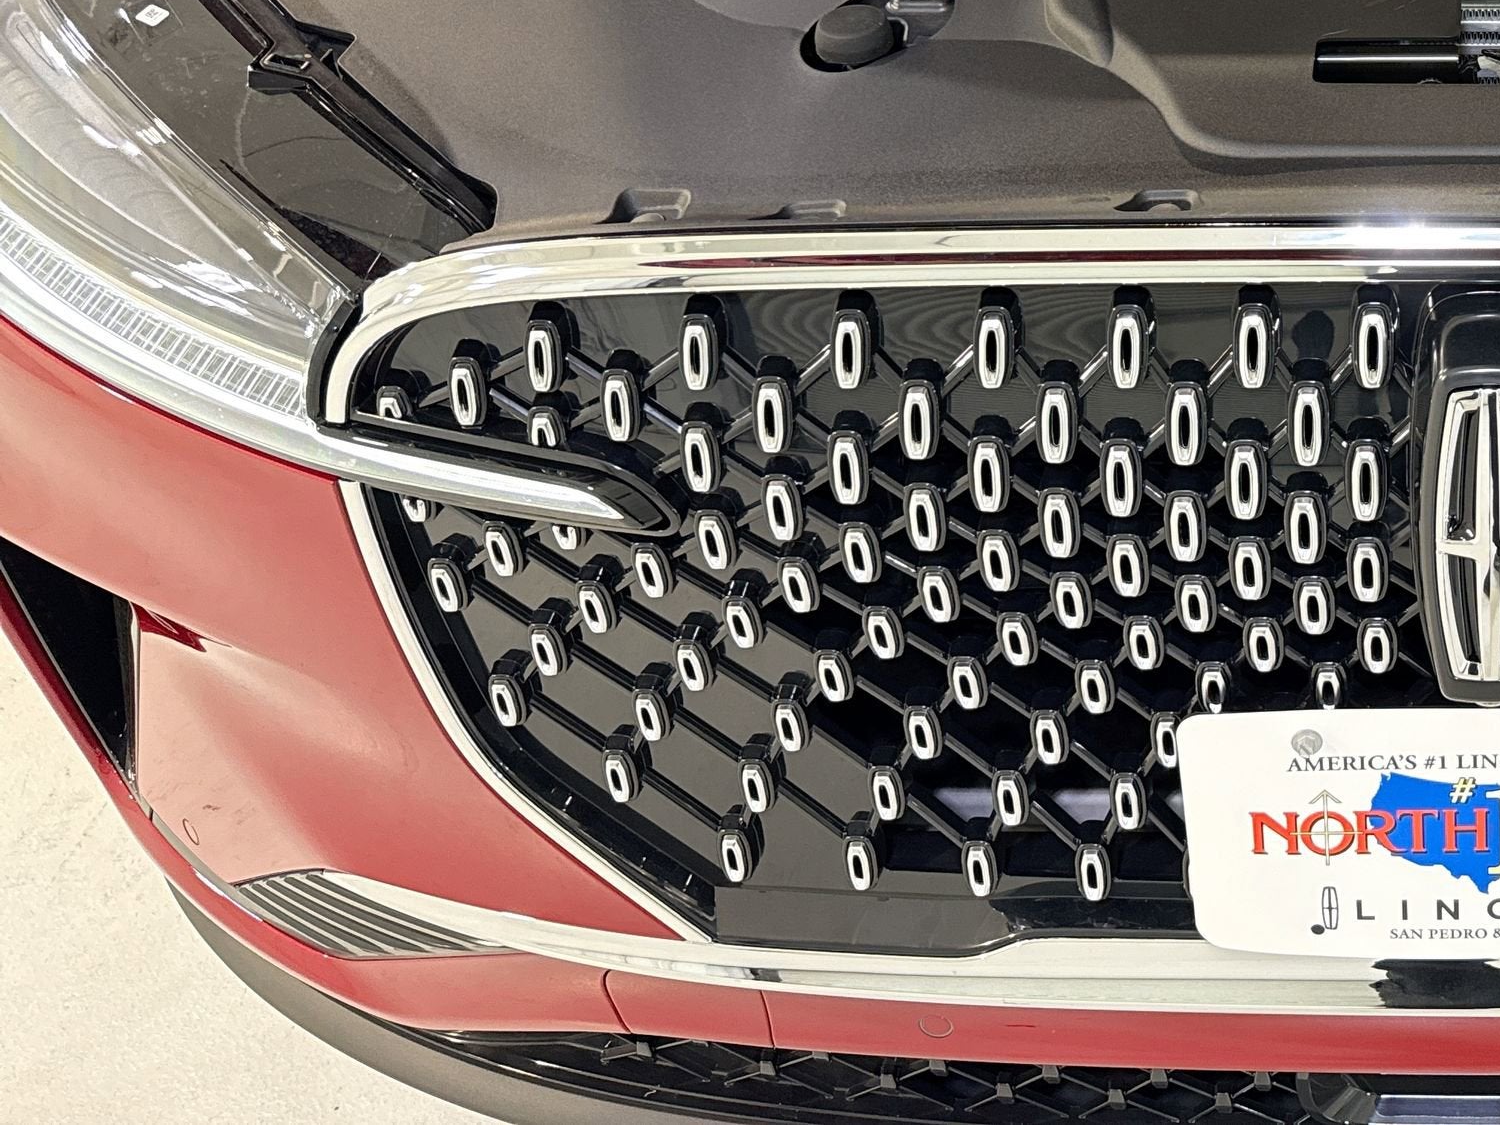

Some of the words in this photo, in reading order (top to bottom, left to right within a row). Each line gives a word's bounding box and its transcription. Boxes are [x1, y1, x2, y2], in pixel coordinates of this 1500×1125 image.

[1287, 754, 1417, 773] AMERICA'S
[1424, 754, 1448, 770] #1
[1248, 807, 1489, 856] NORTH
[1390, 928, 1424, 940] SAN
[1428, 928, 1487, 940] PEDRO
